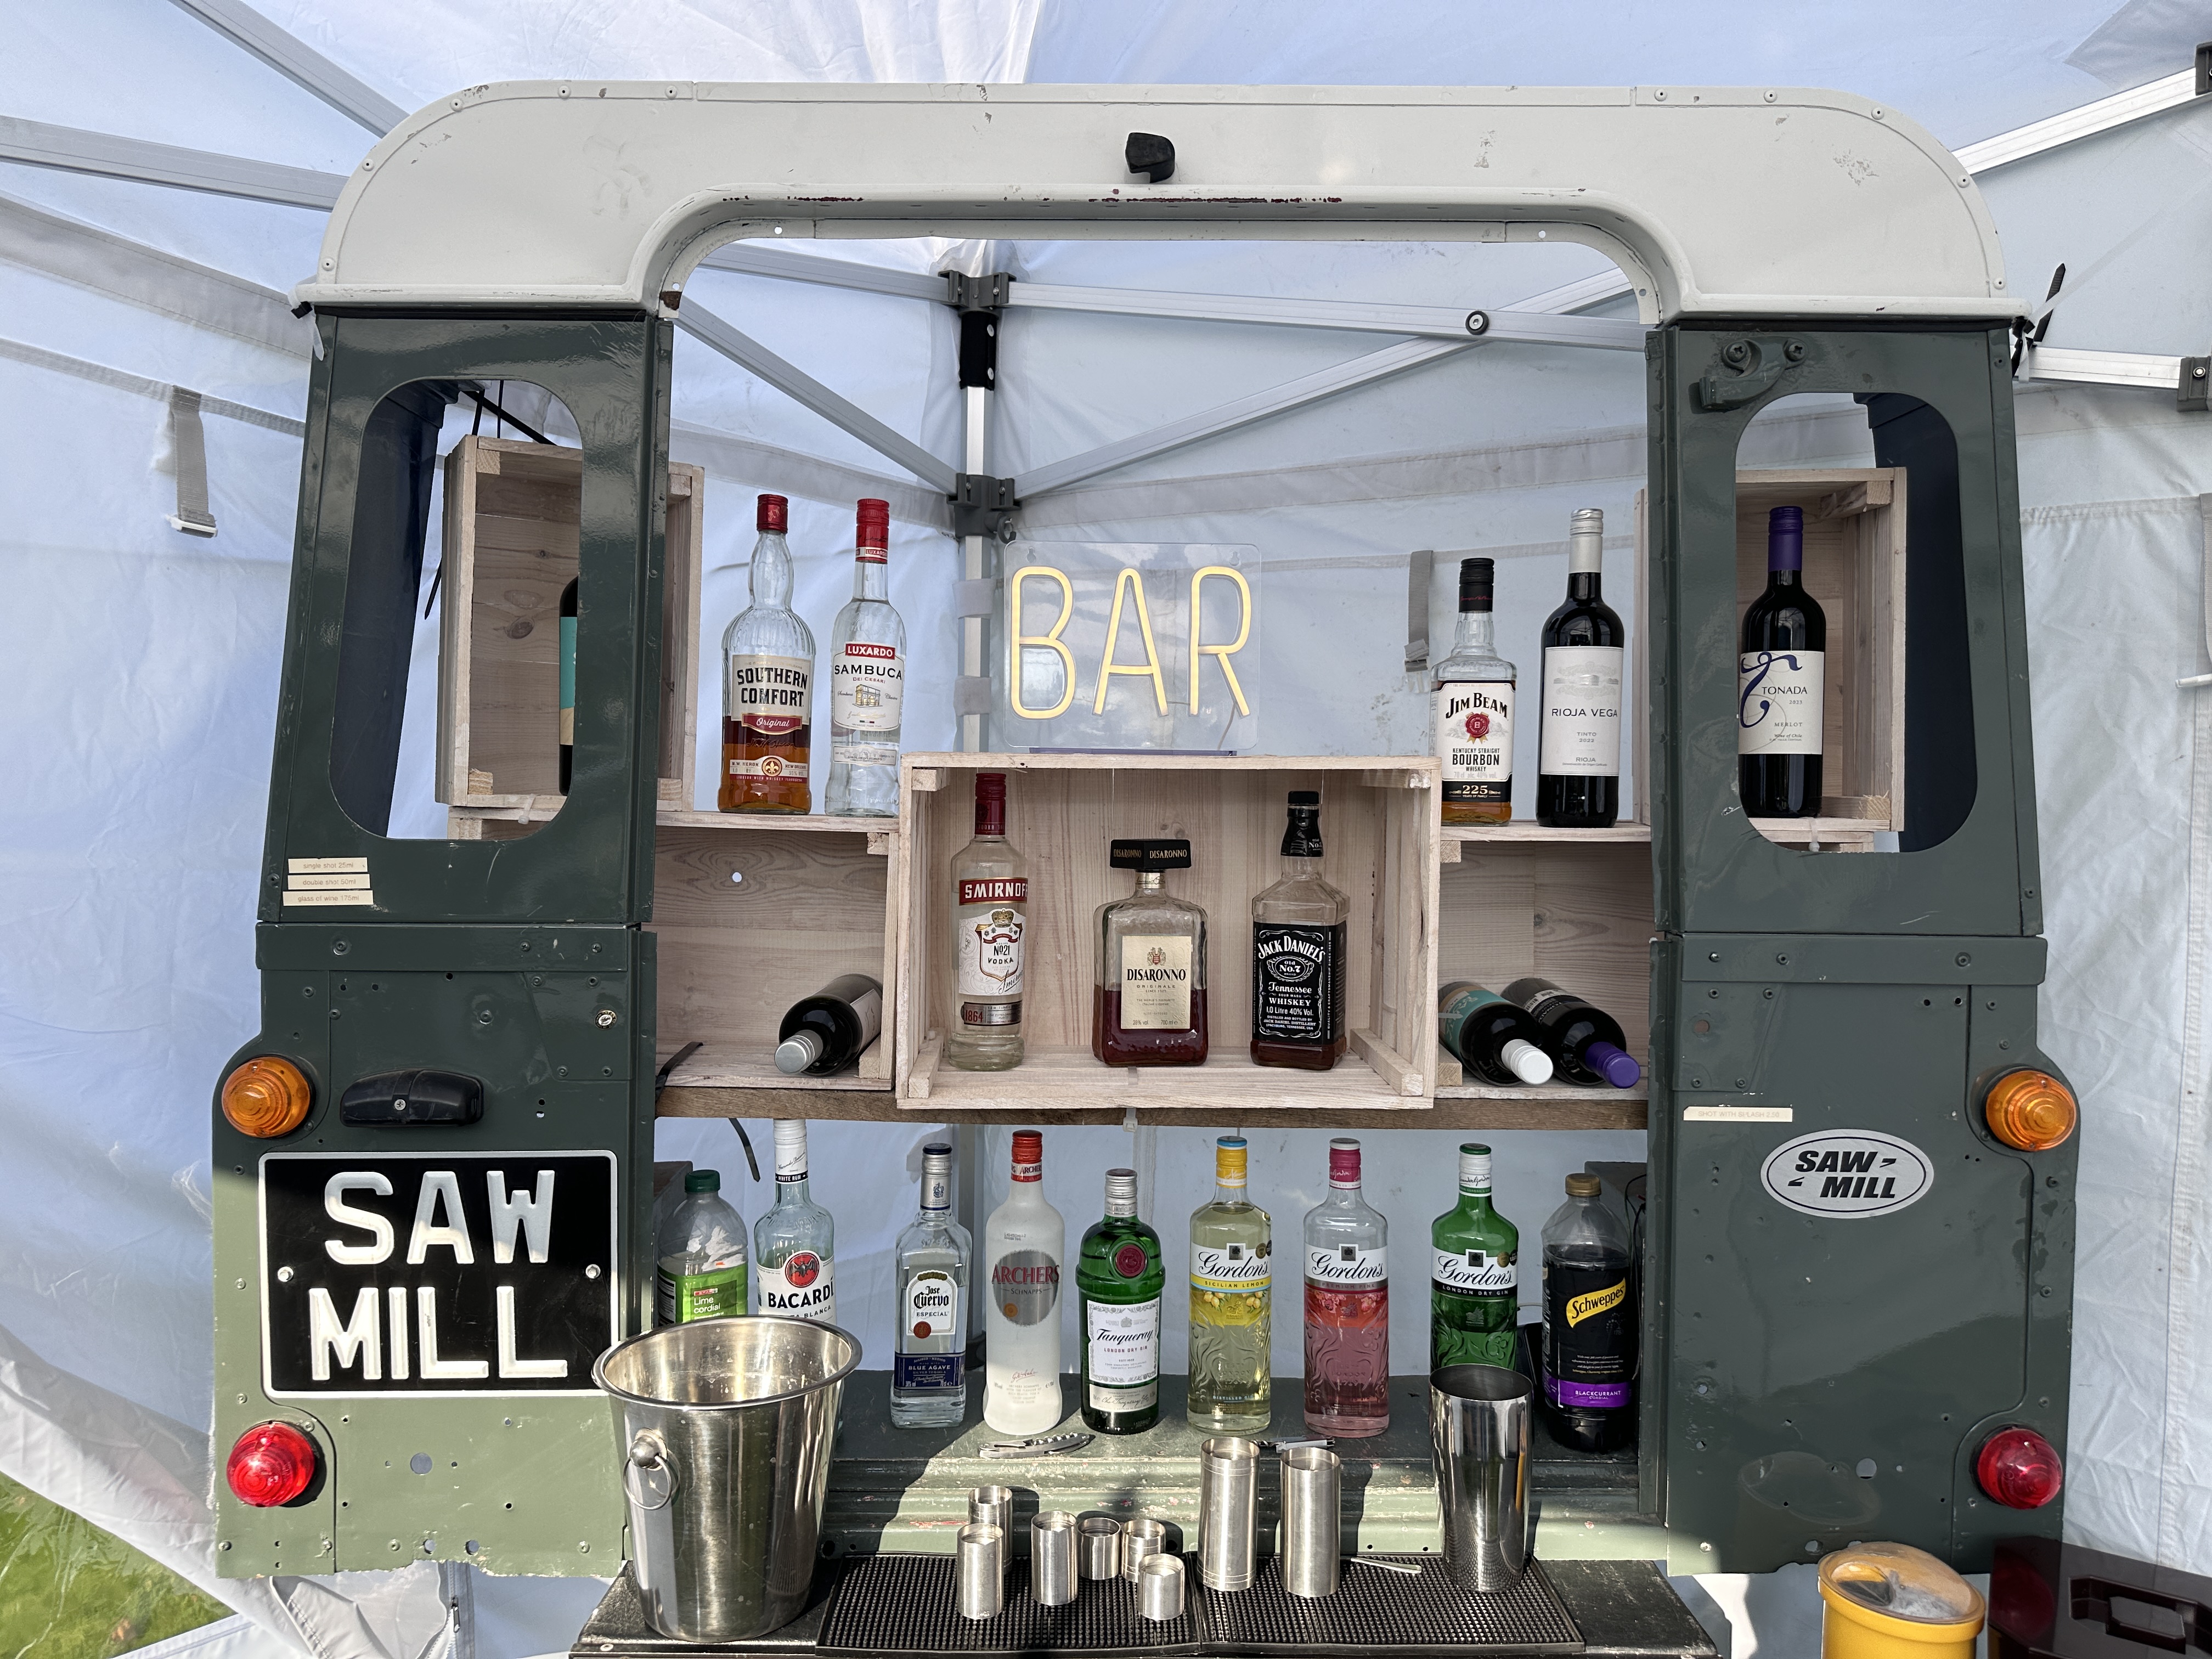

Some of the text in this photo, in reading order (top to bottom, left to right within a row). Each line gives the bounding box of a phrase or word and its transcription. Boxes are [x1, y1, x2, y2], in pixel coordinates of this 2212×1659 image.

[1011, 566, 1251, 719] BAR
[848, 646, 893, 657] LUXARDO
[737, 668, 808, 690] SOUTHERN
[834, 664, 902, 680] SAMBUCA
[741, 688, 804, 707] COMFORT
[1762, 686, 1808, 695] TONADA
[1446, 692, 1508, 719] JIM BEAM
[1551, 708, 1618, 717] RIOJA VEGA
[756, 718, 790, 728] Original
[1452, 754, 1499, 765] BOURBON
[1462, 785, 1488, 794] 225
[1114, 849, 1142, 859] DISARONNO
[1149, 849, 1187, 859] DISARONNO
[1257, 935, 1325, 962] JACK DANIEL'S
[1127, 969, 1186, 982] DISARONNO
[1279, 964, 1301, 973] No.7
[1268, 981, 1312, 994] Tennessee
[1268, 997, 1311, 1006] WHISKEY
[966, 1010, 983, 1023] 1864
[1795, 1150, 1879, 1173] SAW
[1819, 1176, 1896, 1198] MILL
[324, 1170, 555, 1265] SAW
[1198, 1251, 1268, 1278] Gordon's
[1311, 1252, 1383, 1279] Gordon's
[1438, 1255, 1512, 1285] Gordon's
[991, 1263, 1060, 1284] ARCHERS
[768, 1275, 833, 1308] BACARDÍ
[925, 1286, 940, 1295] Jose
[1442, 1285, 1473, 1295] LONDON
[694, 1297, 714, 1305] Lime
[913, 1291, 949, 1309] Cuervo
[1572, 1287, 1623, 1319] Schweppes
[693, 1302, 720, 1313] cordial
[804, 1305, 831, 1318] BLANCA
[308, 1286, 568, 1381] MILL
[1096, 1328, 1154, 1345] Tanqueray
